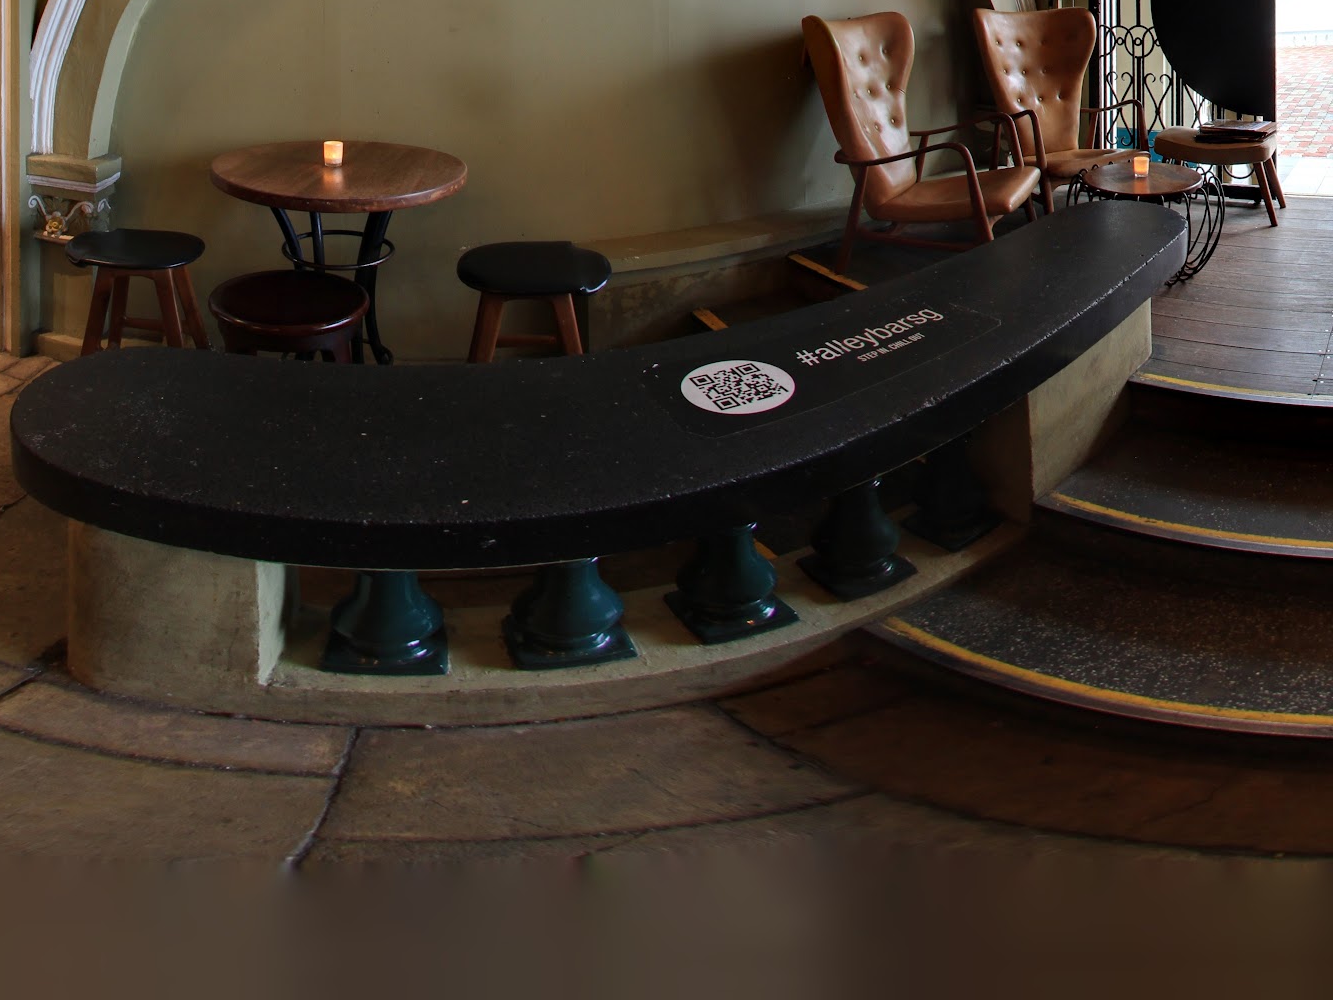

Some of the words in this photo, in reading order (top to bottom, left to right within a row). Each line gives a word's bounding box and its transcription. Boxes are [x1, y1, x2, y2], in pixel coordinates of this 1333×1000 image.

[796, 308, 944, 366] #alleybarsg
[857, 351, 878, 362] STEP
[888, 338, 911, 350] CHILL
[910, 332, 925, 342] OUT
